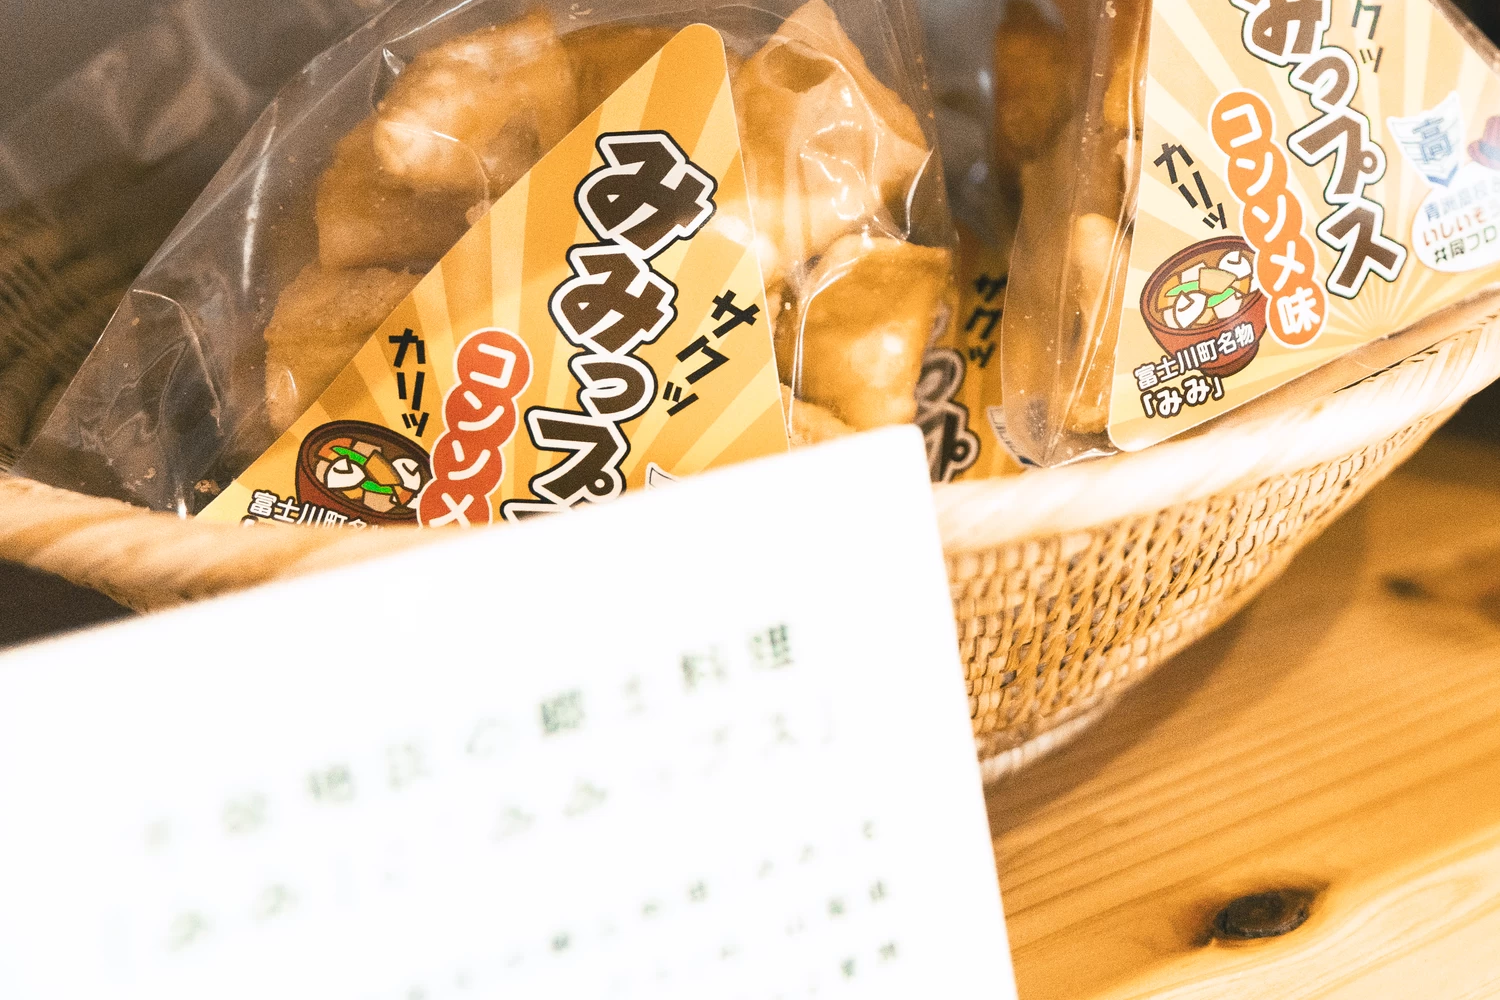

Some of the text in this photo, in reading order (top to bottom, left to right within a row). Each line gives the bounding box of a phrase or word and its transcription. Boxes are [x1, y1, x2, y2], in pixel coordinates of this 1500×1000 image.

[1153, 142, 1228, 231] カリッ
[1219, 102, 1322, 336] コンソメ味
[388, 328, 430, 438] カリッ
[676, 289, 761, 417] サクッ
[1134, 322, 1256, 391] 富士川町名物
[1140, 376, 1225, 418] 「みみ」
[248, 490, 385, 531] 富士川町
